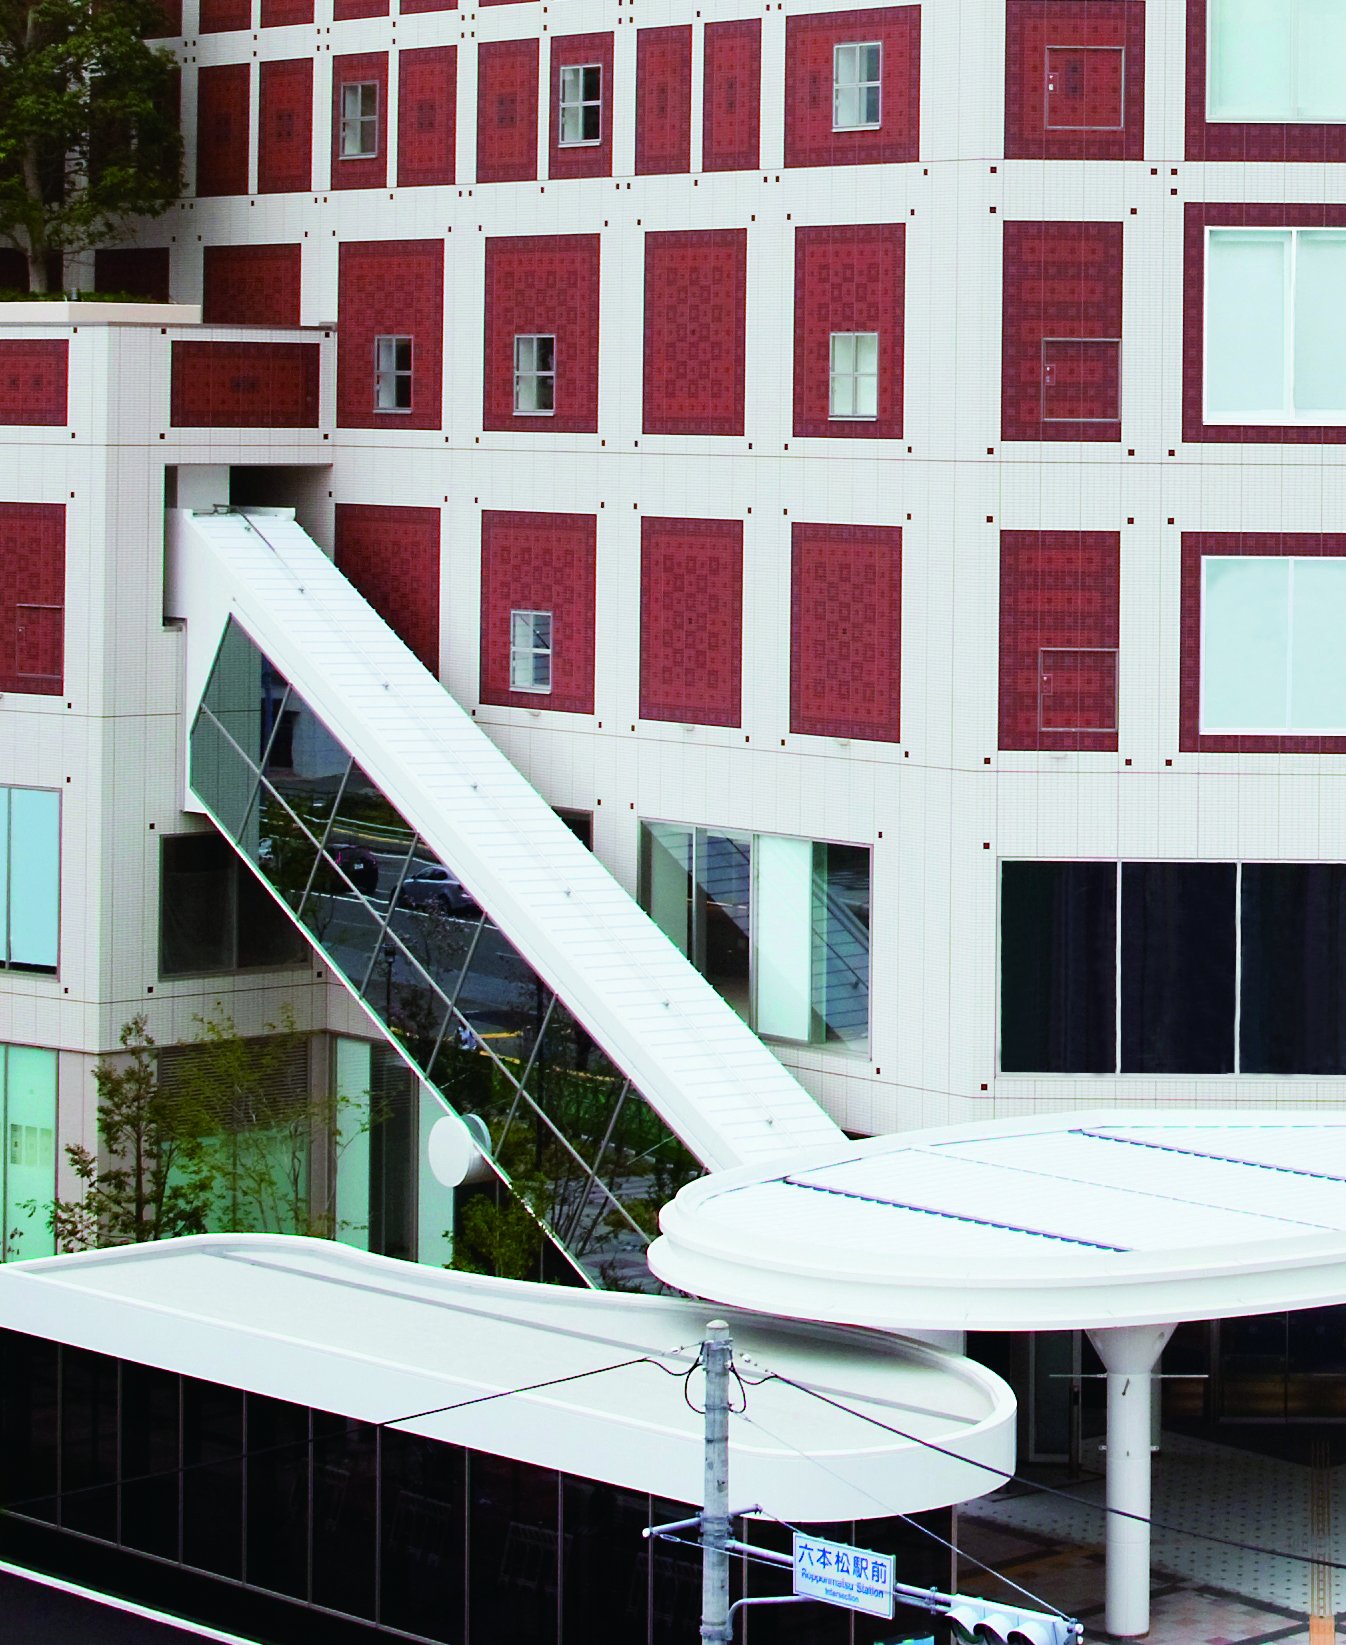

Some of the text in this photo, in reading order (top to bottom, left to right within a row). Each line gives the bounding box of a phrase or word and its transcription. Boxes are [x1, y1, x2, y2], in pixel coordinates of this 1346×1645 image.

[798, 1543, 887, 1584] 六本松駅前
[856, 1582, 884, 1598] Station
